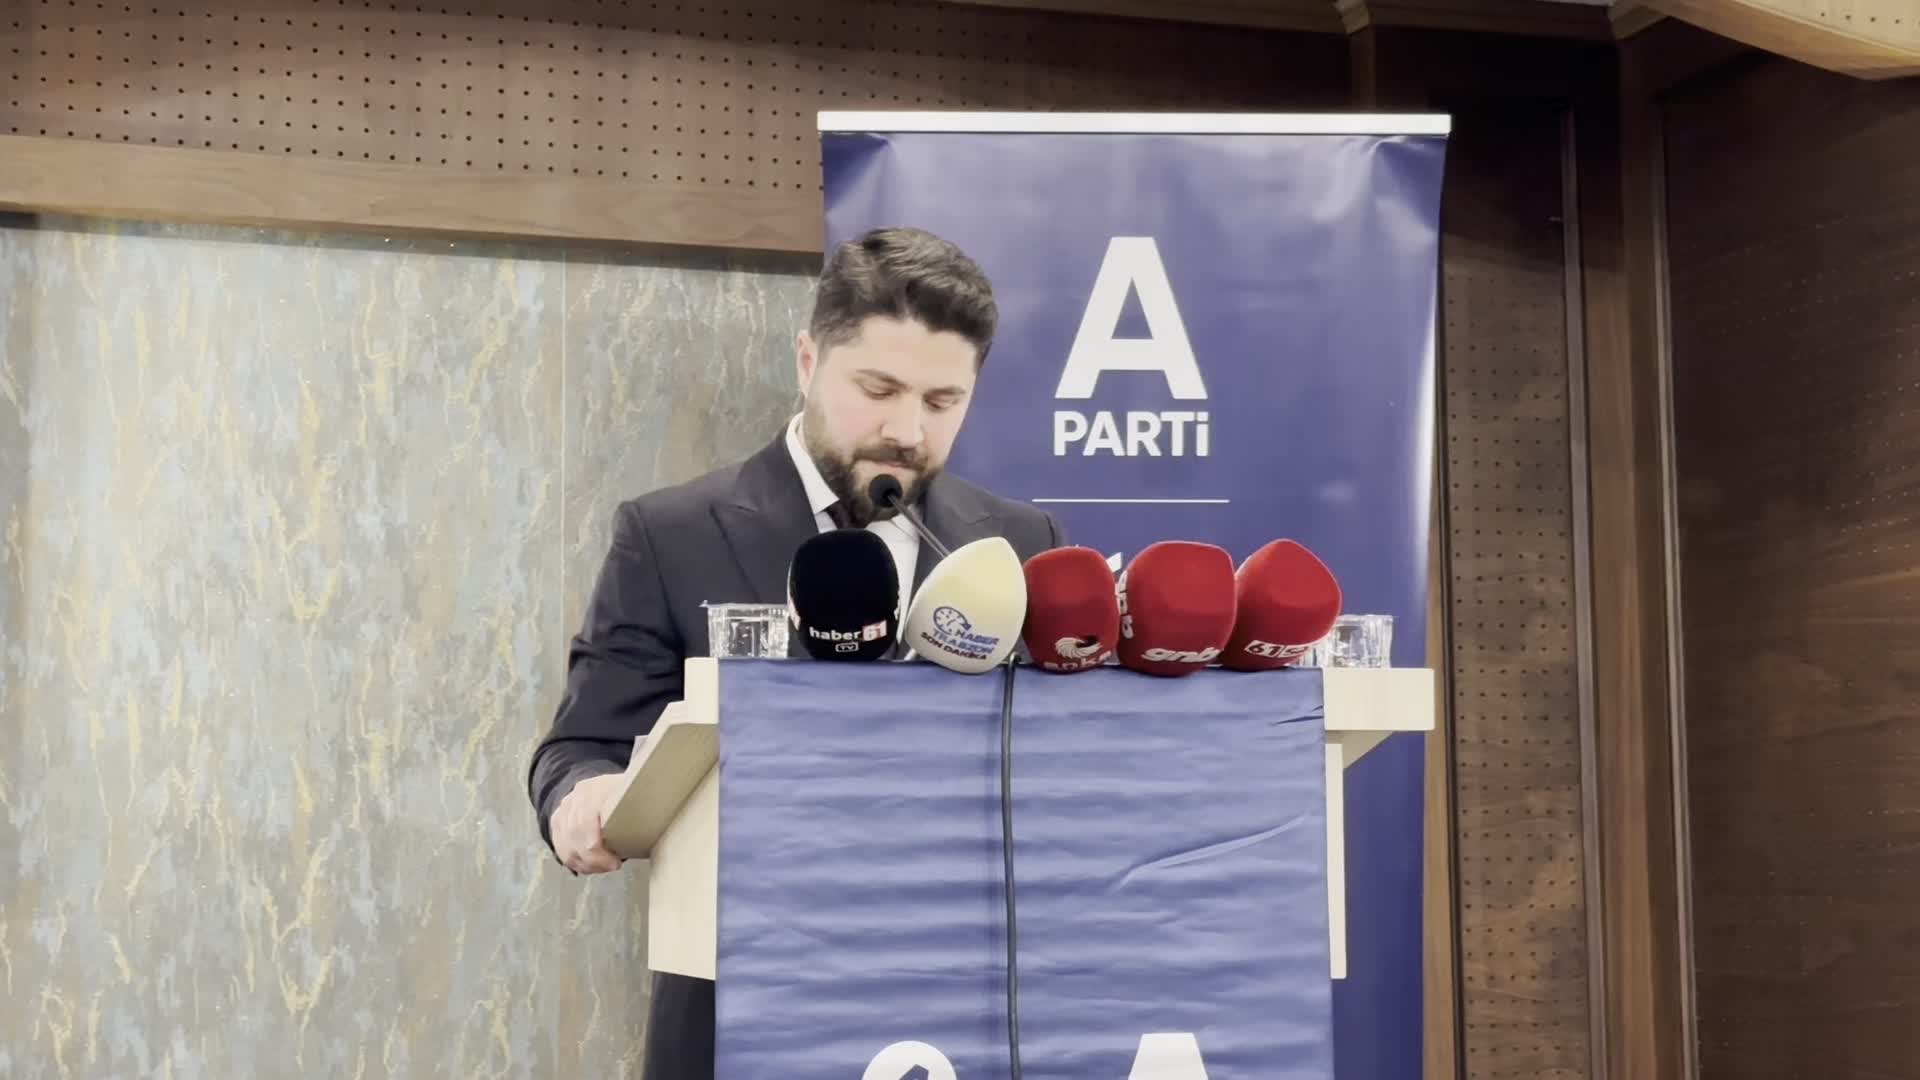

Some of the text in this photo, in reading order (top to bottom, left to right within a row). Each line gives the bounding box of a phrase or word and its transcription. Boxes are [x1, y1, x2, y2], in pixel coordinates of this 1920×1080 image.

[1054, 236, 1209, 400] A
[920, 631, 943, 649] SON
[954, 629, 1000, 646] HABER
